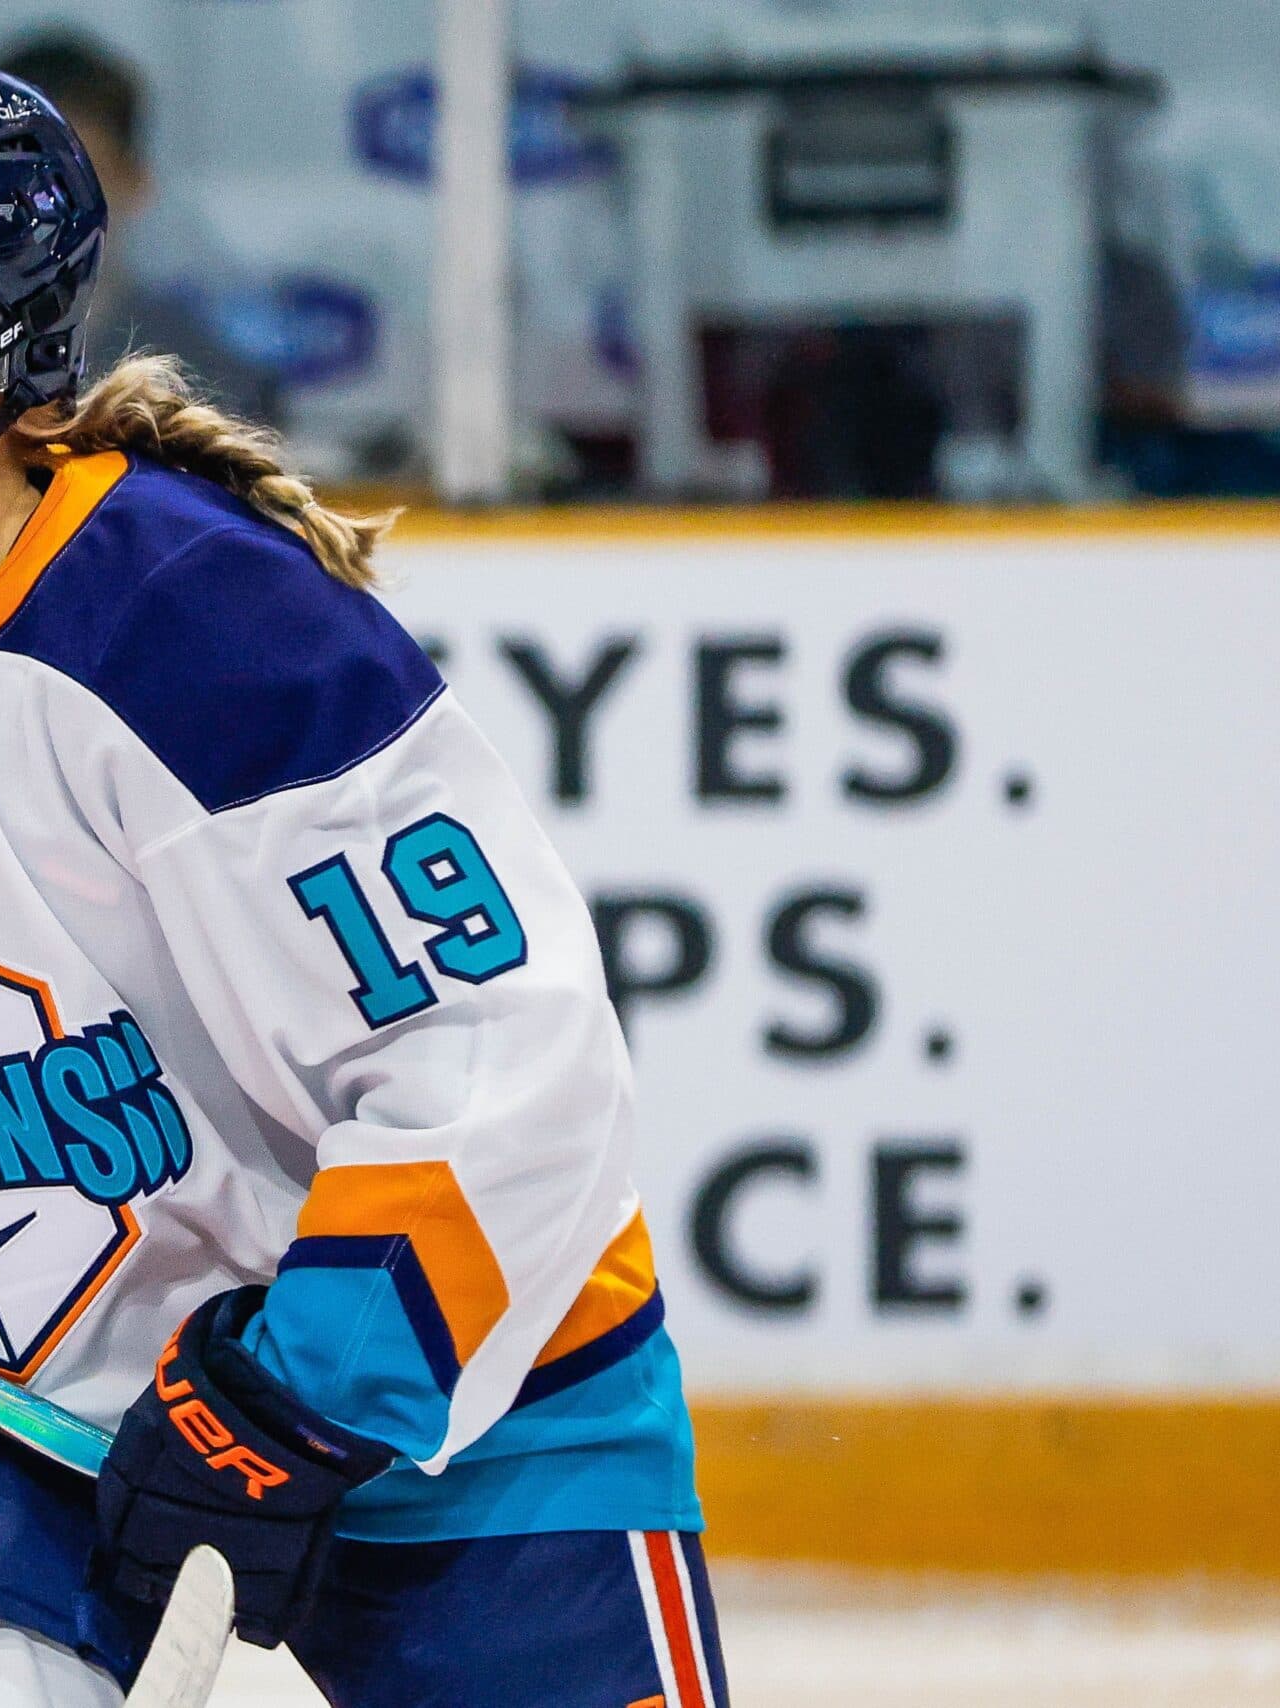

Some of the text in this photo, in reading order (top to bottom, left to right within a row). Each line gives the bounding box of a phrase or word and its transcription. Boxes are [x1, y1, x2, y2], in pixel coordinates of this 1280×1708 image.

[418, 628, 1038, 810] YES.
[286, 811, 528, 1031] 19
[592, 884, 954, 1064] PS.
[684, 1138, 1054, 1320] CE.
[155, 1311, 291, 1500] UER
